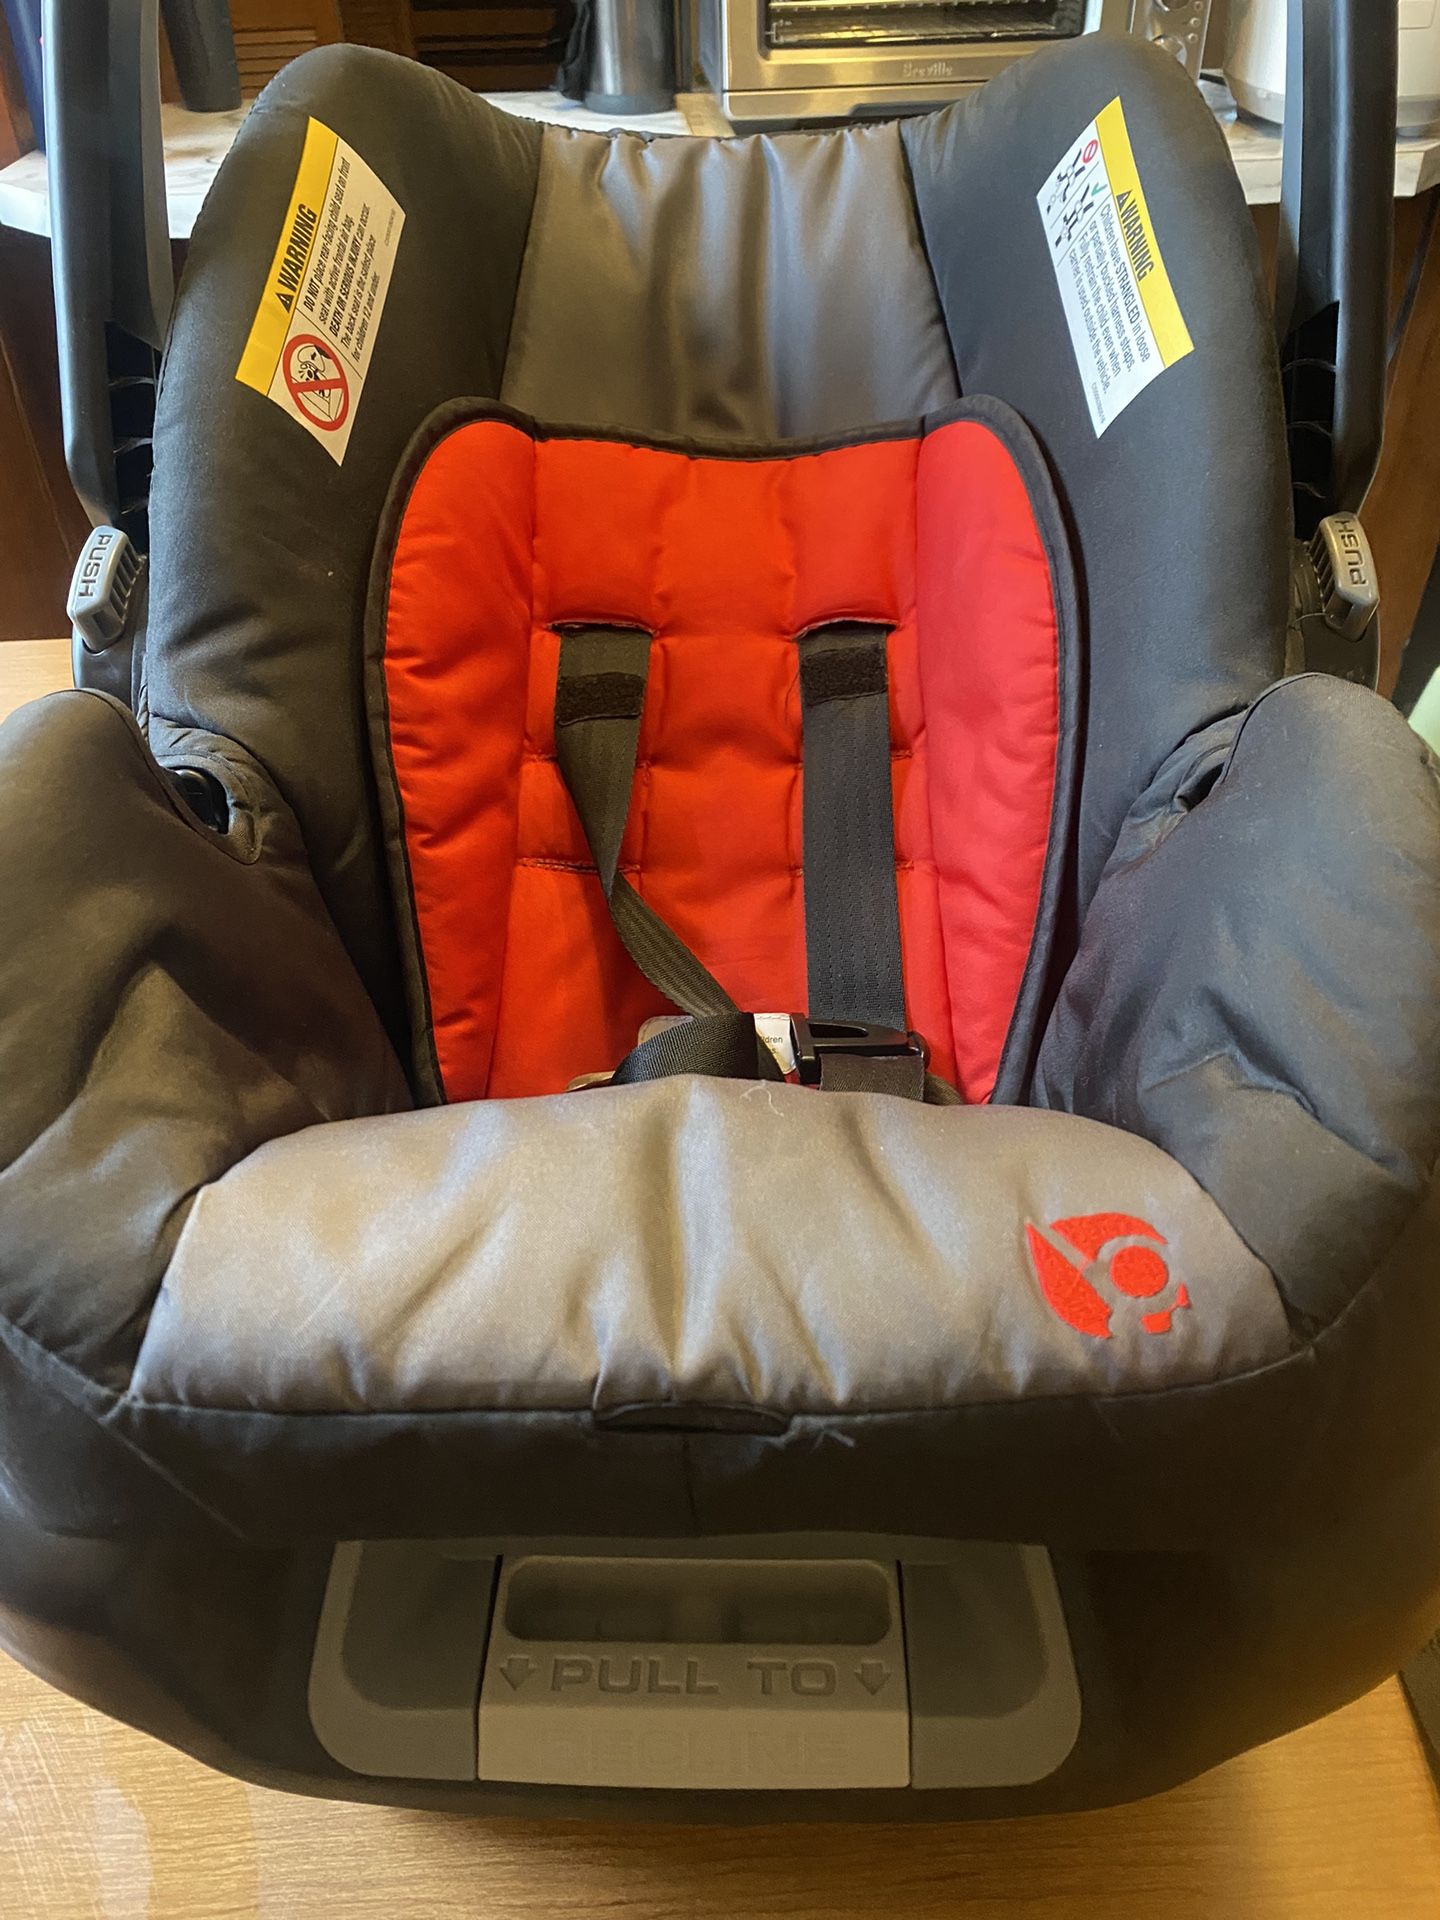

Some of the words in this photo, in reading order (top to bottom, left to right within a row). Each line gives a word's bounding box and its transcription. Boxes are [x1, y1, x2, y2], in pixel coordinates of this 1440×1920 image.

[338, 156, 350, 178] front
[335, 183, 344, 204] seat
[338, 175, 346, 188] on
[331, 198, 340, 222] child
[1090, 221, 1097, 233] or
[1101, 204, 1114, 245] Children
[277, 203, 317, 292] WARNING
[320, 219, 338, 262] rear-facing
[332, 238, 347, 267] frontal
[347, 235, 360, 268] INJURY
[366, 234, 377, 260] place
[1080, 232, 1089, 259] Fully
[1089, 231, 1106, 269] partially
[1110, 239, 1120, 267] have
[1121, 199, 1154, 282] WARNING
[313, 258, 326, 285] place
[329, 264, 340, 290] active
[361, 253, 371, 280] safest
[1070, 249, 1081, 279] carrier
[1083, 255, 1097, 291] restrain
[307, 278, 320, 300] NOT
[339, 263, 355, 300] SERIOUS
[356, 276, 366, 292] the
[1076, 273, 1083, 288] is
[1100, 262, 1117, 302] buckled
[1116, 261, 1140, 324] STRANGLED
[304, 295, 316, 312] DO
[324, 286, 334, 306] with
[337, 296, 347, 312] OR
[352, 295, 360, 316] seat
[354, 289, 362, 300] is
[366, 291, 374, 311] and
[1077, 285, 1089, 310] used
[1092, 286, 1101, 306] the
[319, 303, 329, 324] seat
[329, 307, 343, 337] DEATH
[344, 312, 356, 335] back
[363, 306, 371, 320] 12
[1084, 308, 1097, 343] outside
[1096, 304, 1109, 328] child
[1110, 297, 1125, 339] harness
[341, 332, 352, 349] The
[355, 318, 367, 350] children
[1102, 326, 1114, 351] even
[1132, 320, 1142, 336] in
[350, 348, 360, 362] for
[1091, 339, 1101, 359] the
[1120, 336, 1134, 372] straps.
[1135, 331, 1150, 363] loose
[1096, 355, 1110, 394] vehicle.
[1108, 348, 1121, 377] when
[78, 534, 113, 597] PUSH
[1335, 520, 1367, 585] PUSH
[550, 1656, 719, 1694] PULL
[747, 1658, 837, 1696] TO
